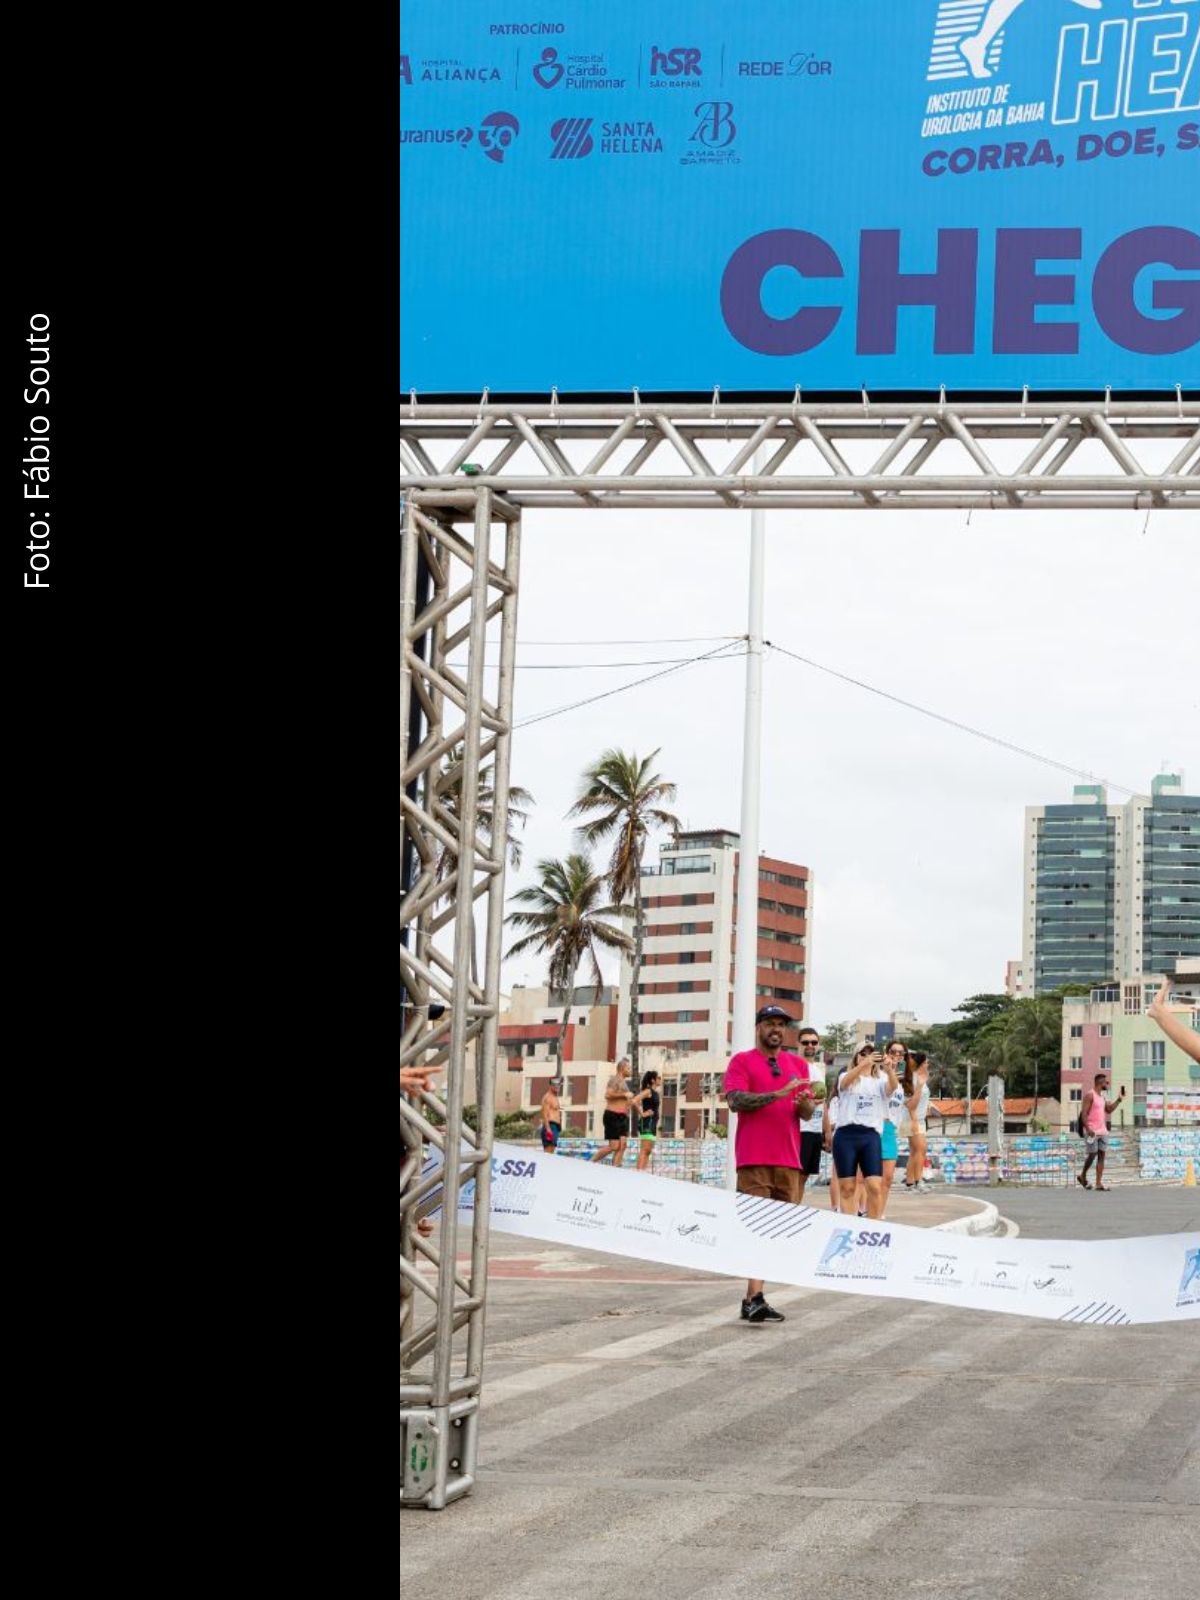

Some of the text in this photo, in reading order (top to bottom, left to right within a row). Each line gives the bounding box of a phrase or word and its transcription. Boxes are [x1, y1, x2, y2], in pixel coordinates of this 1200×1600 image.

[490, 22, 564, 36] PATROCÍNIO
[421, 68, 501, 83] ALIANÇA
[567, 64, 606, 76] Cárdio
[739, 62, 784, 76] REDE
[566, 77, 626, 89] Pulmonar
[926, 85, 1010, 114] INSTITUTO DE
[921, 102, 1046, 137] UROLOGIA DA BAHIA
[601, 122, 655, 138] SANTA
[601, 138, 662, 154] HELENA
[922, 139, 1064, 177] CORRA,
[1077, 127, 1165, 160] DOE,
[501, 1160, 537, 1178] SSA
[856, 1231, 891, 1248] SSA
